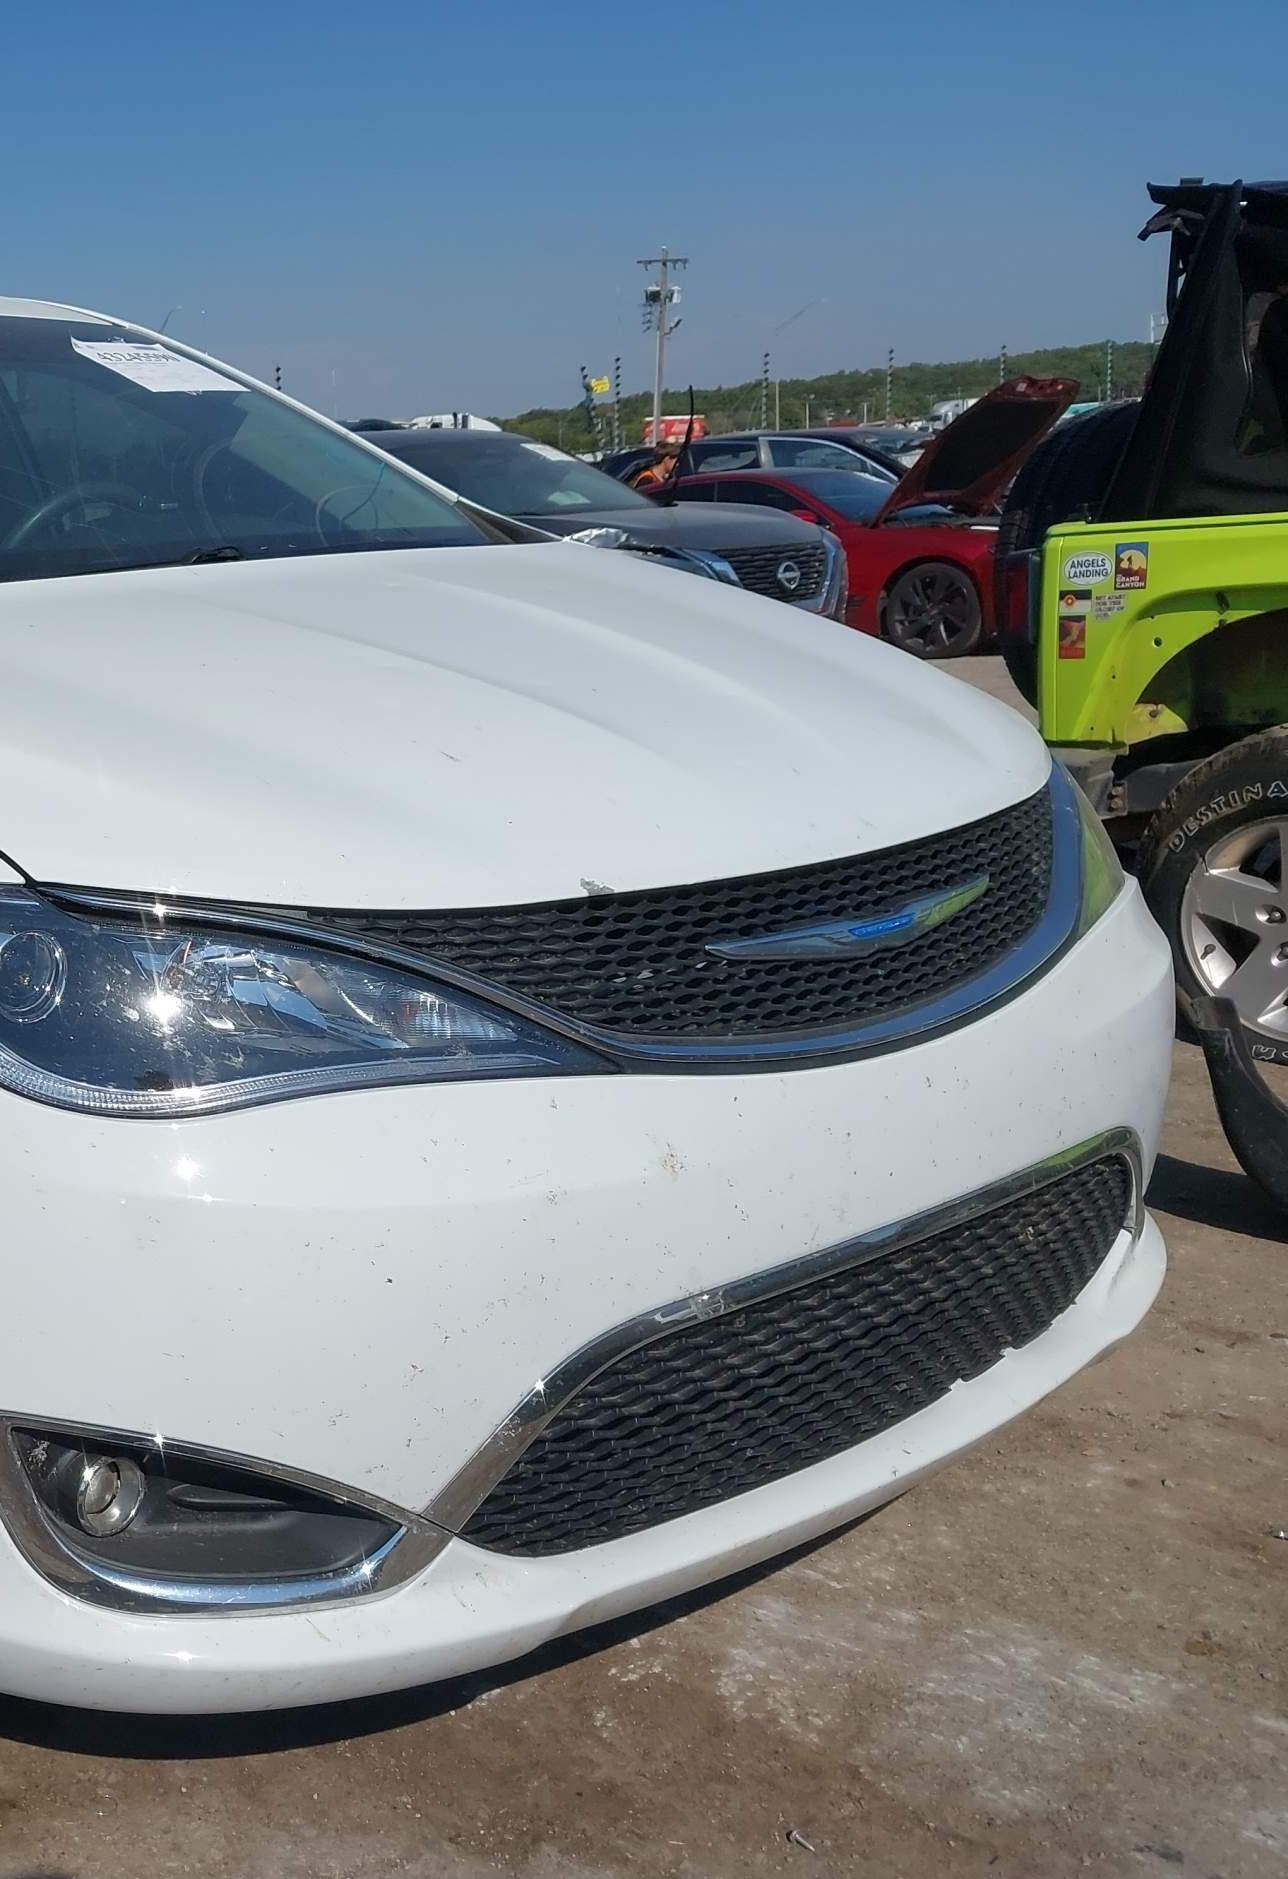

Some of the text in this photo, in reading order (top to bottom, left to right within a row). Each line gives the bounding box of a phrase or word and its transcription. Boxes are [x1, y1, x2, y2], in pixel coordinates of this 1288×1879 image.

[1070, 558, 1106, 569] ANGELS
[1068, 568, 1109, 579] LANDING
[1116, 575, 1140, 583] GRAND
